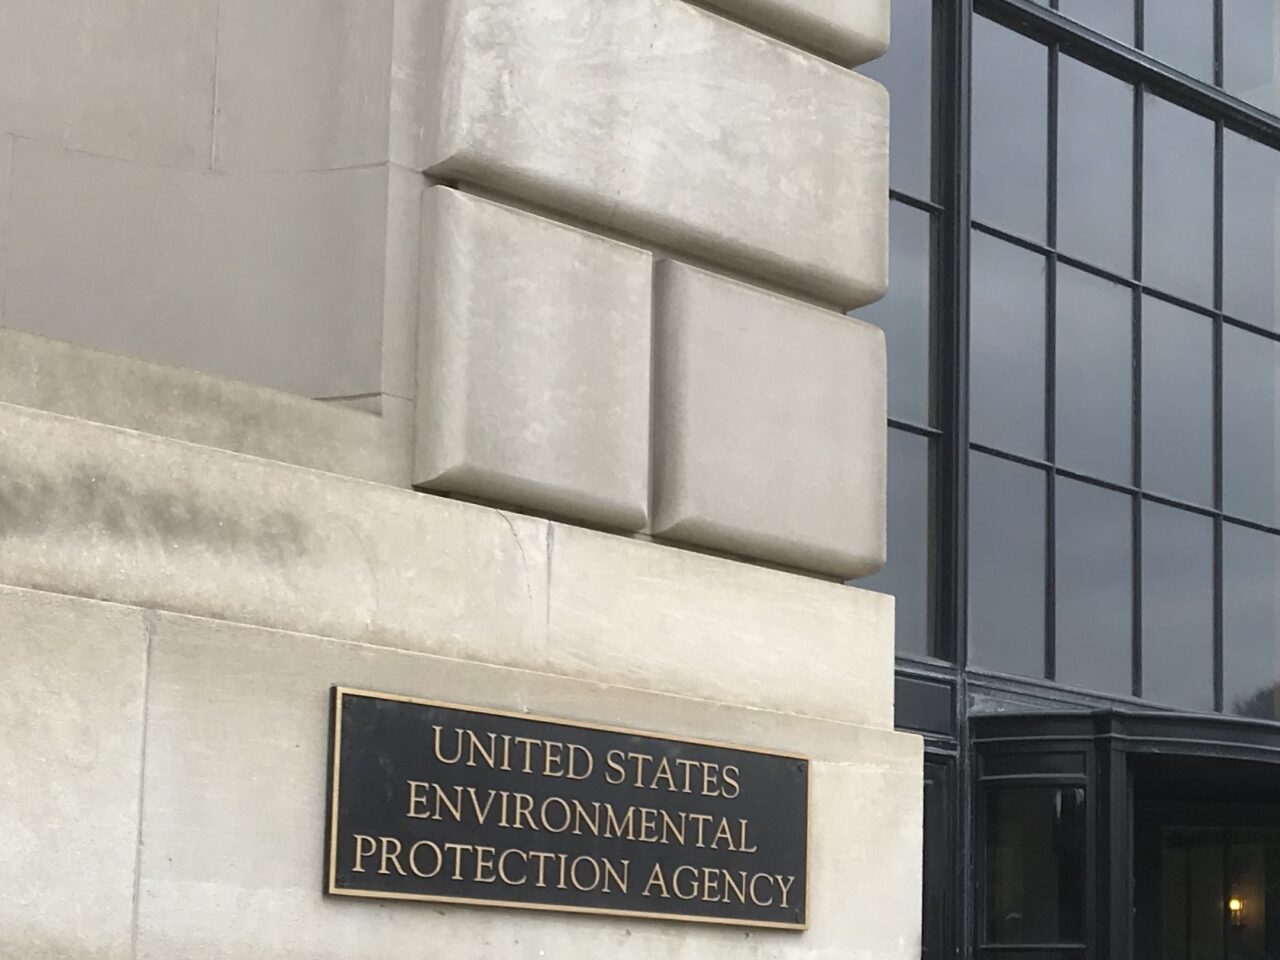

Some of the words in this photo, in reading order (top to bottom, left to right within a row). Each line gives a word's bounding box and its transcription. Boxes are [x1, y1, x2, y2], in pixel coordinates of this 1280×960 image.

[431, 725, 594, 781] UNITED
[604, 749, 741, 799] STATES
[405, 779, 758, 854] ENVIRONMENTAL
[351, 834, 631, 896] PROTECTION
[640, 862, 796, 909] AGENCY
